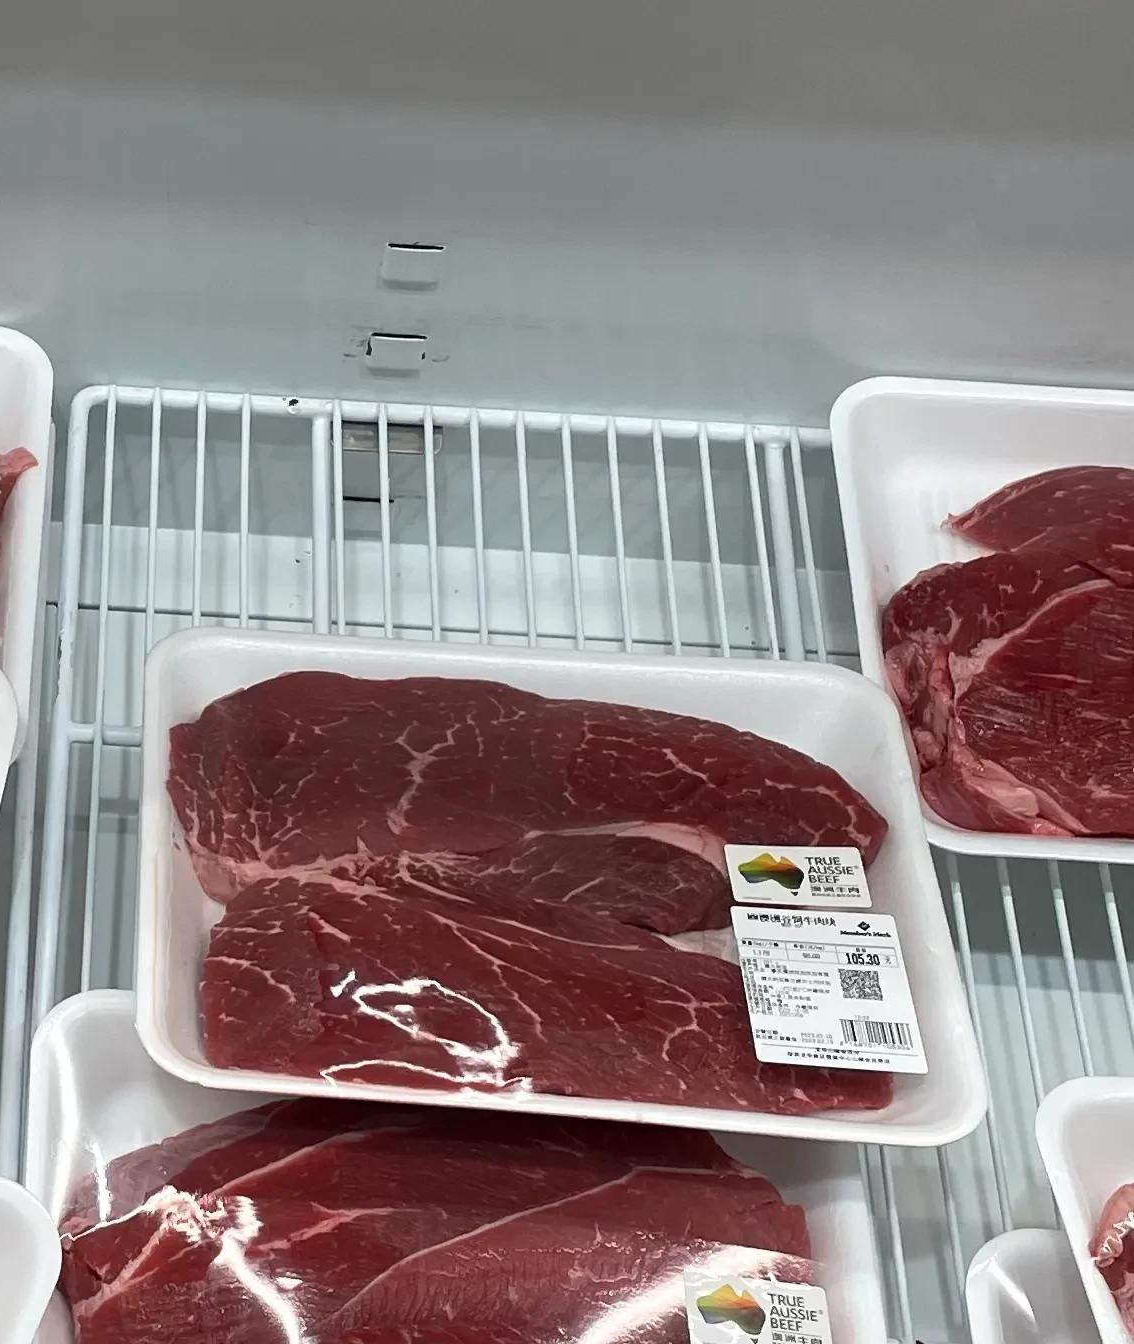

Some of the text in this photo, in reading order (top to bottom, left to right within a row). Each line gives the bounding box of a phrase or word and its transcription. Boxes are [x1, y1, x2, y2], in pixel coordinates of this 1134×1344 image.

[804, 856, 841, 866] TRUE
[807, 865, 854, 876] AUSSIE
[808, 874, 840, 884] BEEF
[846, 953, 880, 966] 105.30
[767, 1293, 805, 1308] TRUE
[770, 1306, 818, 1322] AUSSIE
[770, 1317, 803, 1331] BEEF
